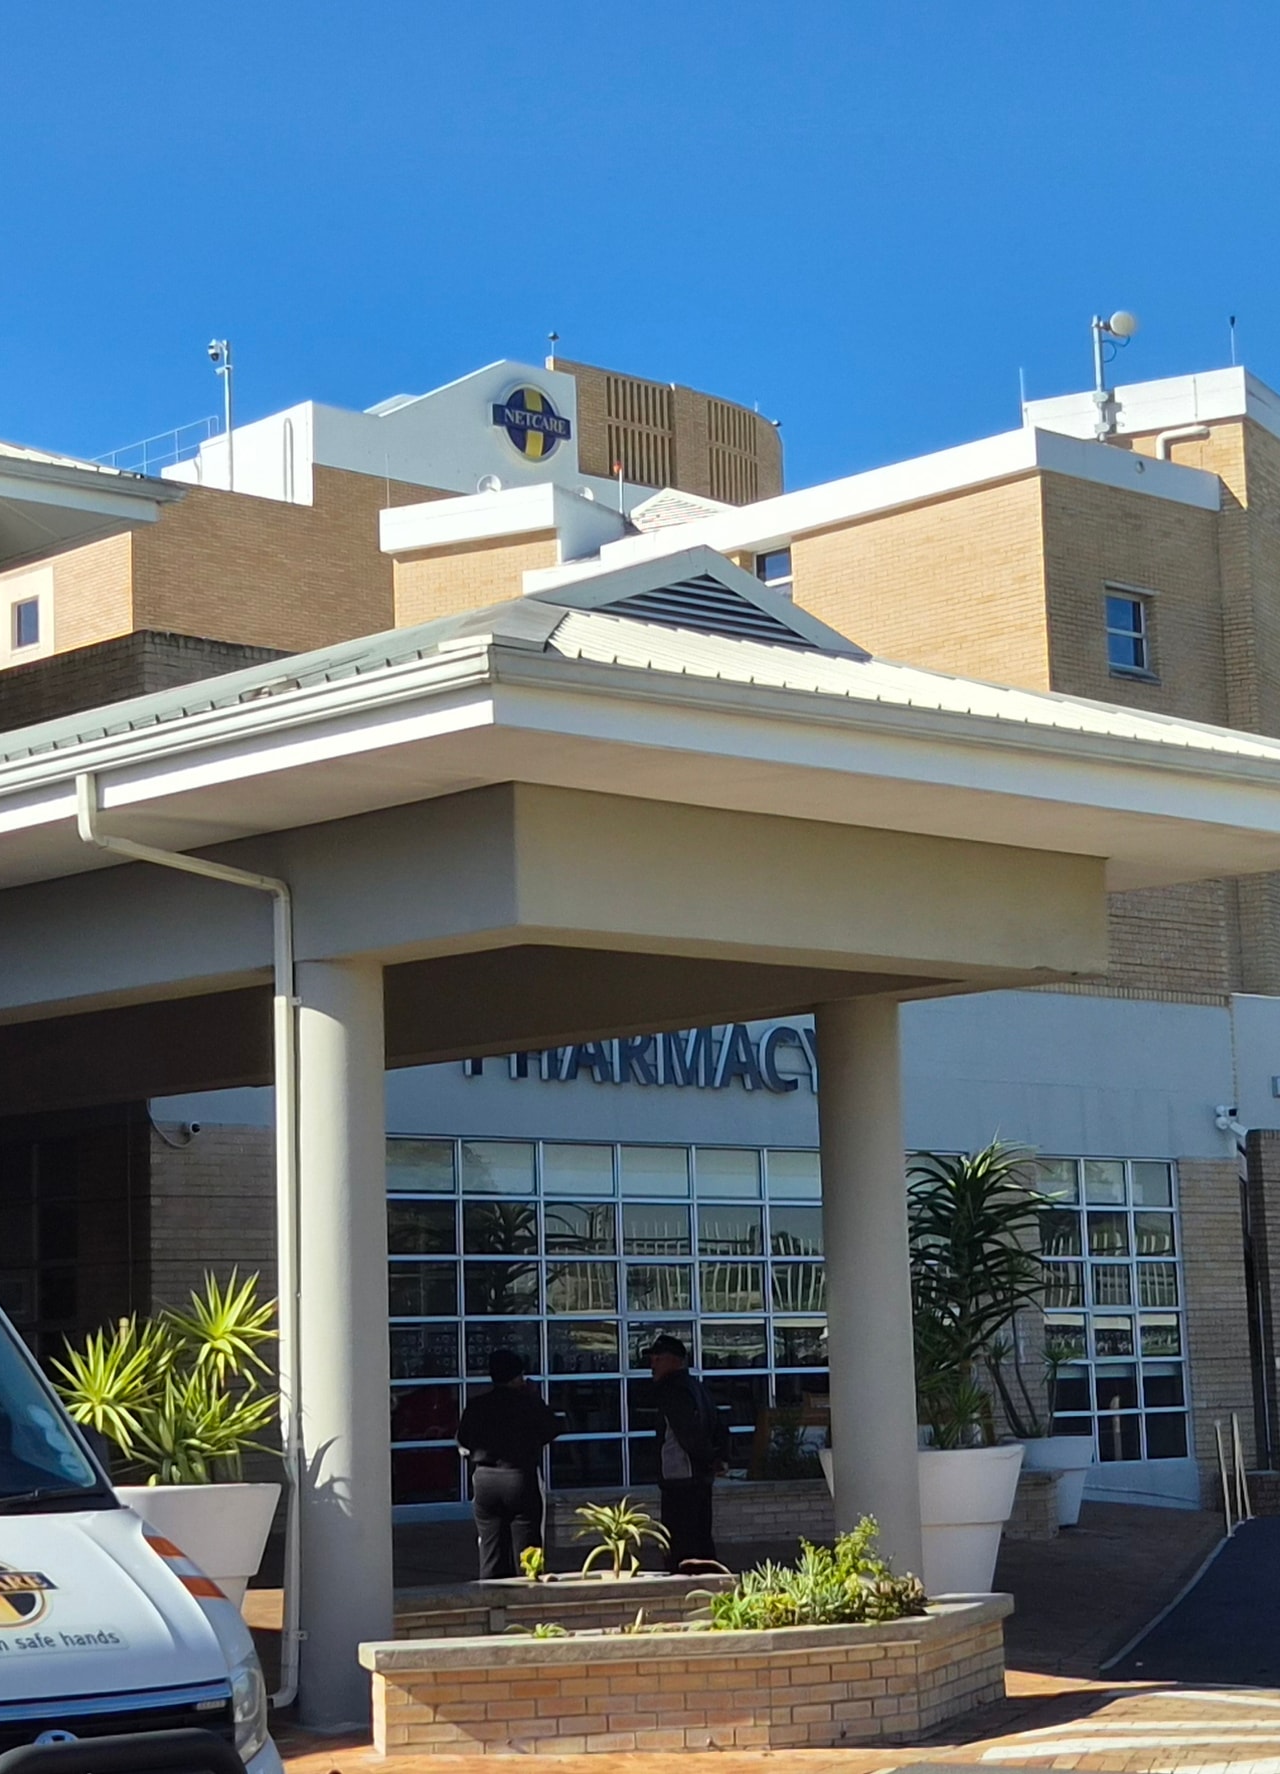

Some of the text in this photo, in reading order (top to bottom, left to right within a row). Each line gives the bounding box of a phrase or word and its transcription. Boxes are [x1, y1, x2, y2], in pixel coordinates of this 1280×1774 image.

[504, 409, 566, 435] NETCARE
[15, 1631, 56, 1651] safe
[59, 1628, 121, 1647] hands
